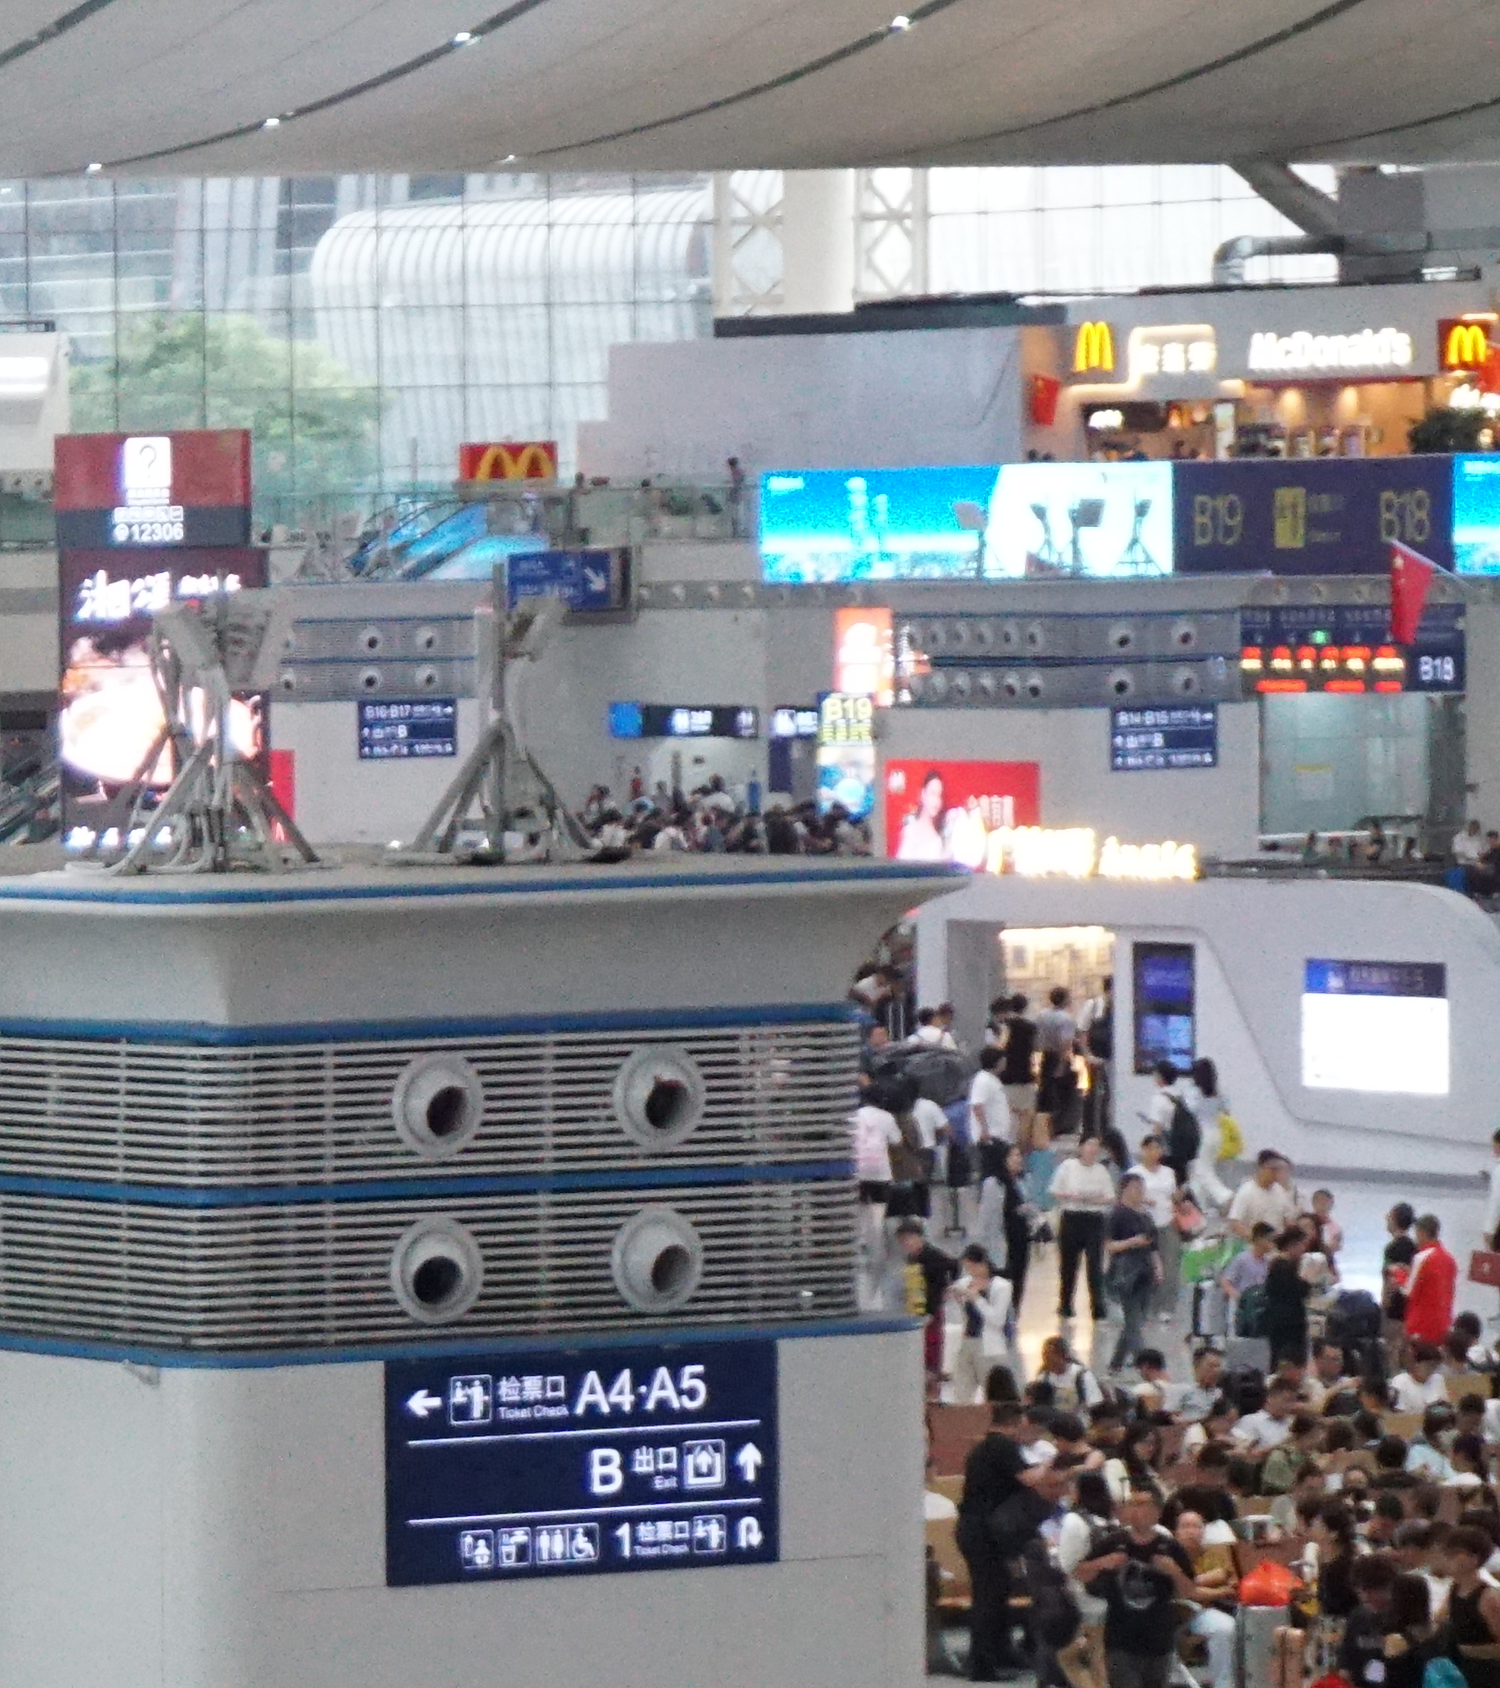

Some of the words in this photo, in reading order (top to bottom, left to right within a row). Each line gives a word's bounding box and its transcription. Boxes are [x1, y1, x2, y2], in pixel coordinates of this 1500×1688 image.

[132, 522, 184, 541] 12306
[1194, 494, 1243, 545] B19
[1379, 489, 1431, 543] B18
[498, 1375, 566, 1403] 检票口
[573, 1364, 708, 1416] A4·A5
[499, 1405, 532, 1420] Ticket
[533, 1404, 569, 1418] Check
[590, 1448, 623, 1495] B
[633, 1445, 678, 1474] 出口
[653, 1475, 678, 1489] Exit
[616, 1521, 631, 1559] 1
[637, 1520, 690, 1542] 检票口
